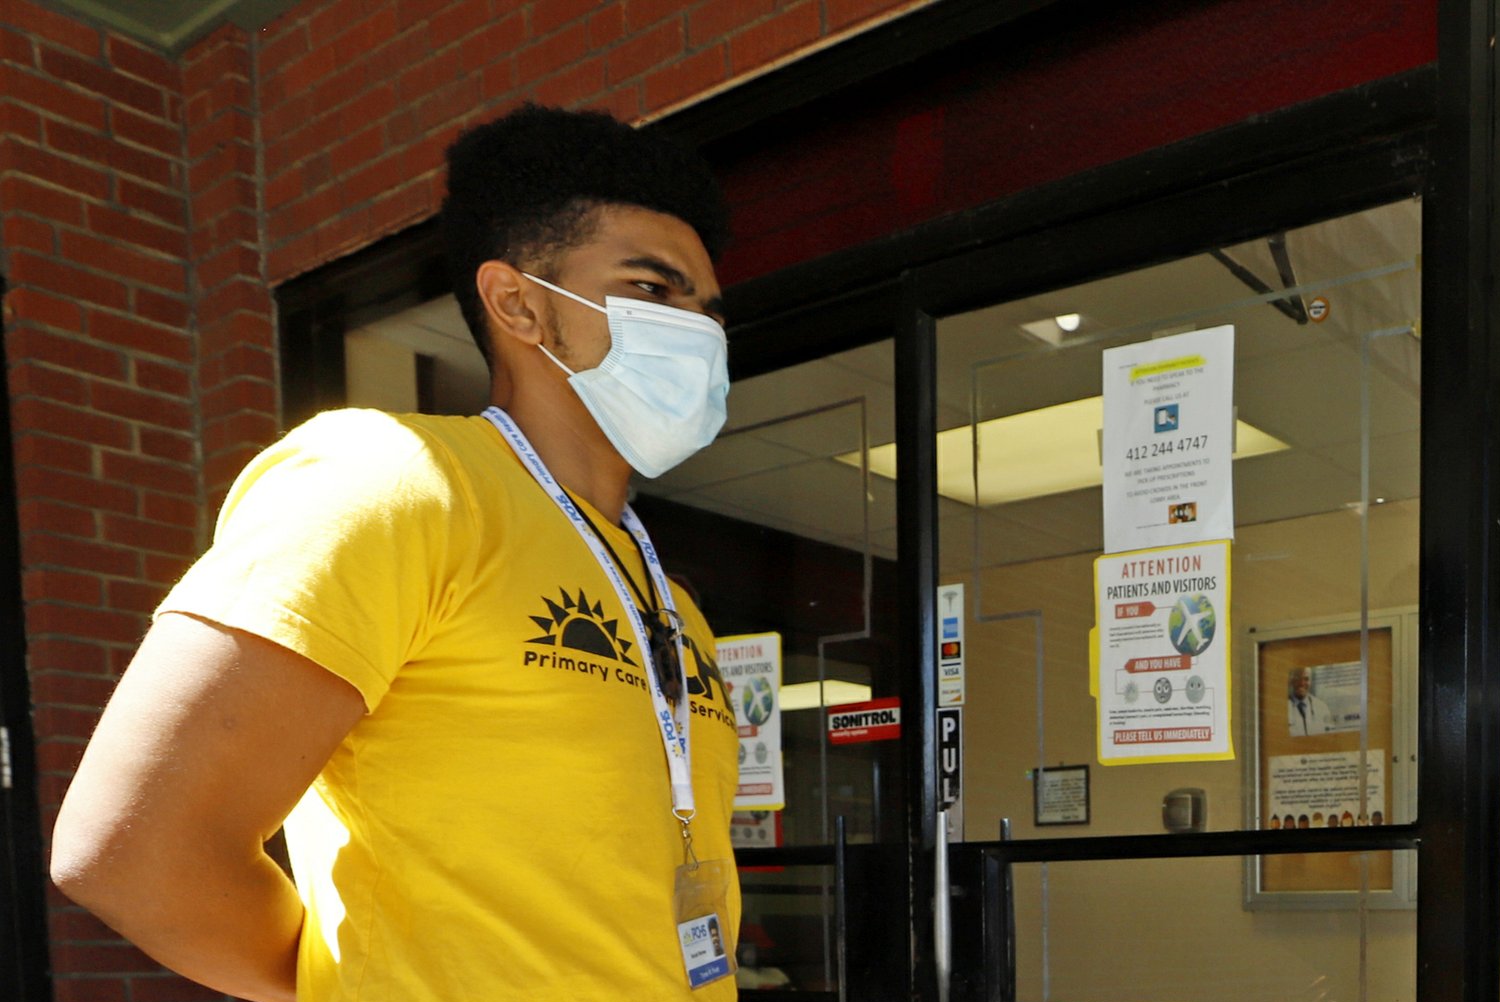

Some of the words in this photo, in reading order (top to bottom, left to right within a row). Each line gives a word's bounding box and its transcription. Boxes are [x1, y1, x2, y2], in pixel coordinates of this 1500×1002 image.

[1126, 445, 1148, 460] 412
[1151, 441, 1173, 457] 244
[1177, 435, 1208, 451] 4747
[1122, 555, 1201, 579] ATTENTION
[1107, 582, 1149, 600] PATIENTS
[1151, 580, 1171, 595] AND
[1173, 576, 1217, 593] VISITORS
[1126, 604, 1139, 617] YOU
[716, 644, 763, 661] TTENTION
[1134, 660, 1148, 671] AND
[1150, 659, 1162, 670] YOU
[1163, 657, 1182, 669] HAVE
[524, 650, 608, 682] Primary
[615, 668, 647, 691] Care
[690, 700, 737, 733] Servic
[832, 710, 896, 729] SONITROL
[1115, 731, 1136, 743] PLEASE
[1137, 730, 1152, 743] TELL
[1153, 730, 1163, 742] US
[1163, 728, 1210, 741] IMMEDIATELY
[942, 716, 957, 828] PUL
